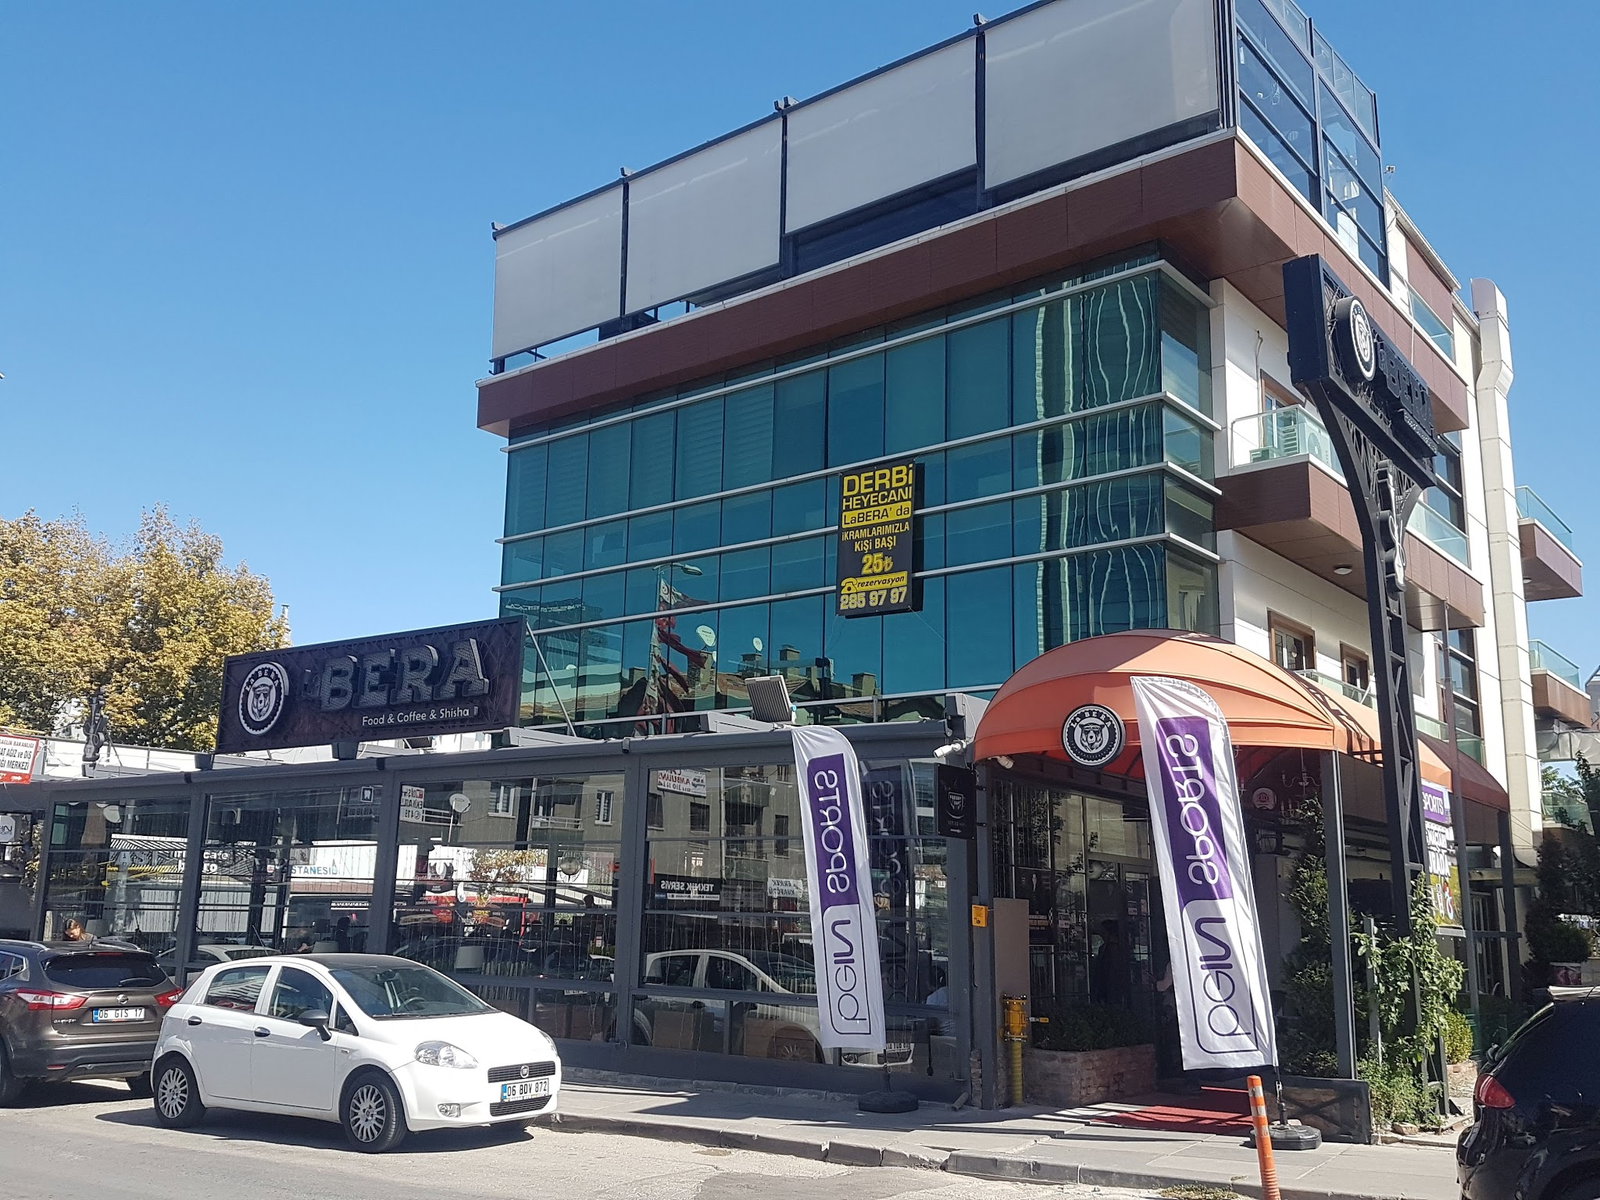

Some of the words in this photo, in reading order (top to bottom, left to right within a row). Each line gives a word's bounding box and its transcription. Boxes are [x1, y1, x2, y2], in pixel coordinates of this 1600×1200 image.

[842, 486, 912, 510] HEYECANI
[874, 536, 896, 550] BAŞI
[857, 575, 905, 588] rezervasyon
[869, 589, 887, 607] 97
[890, 586, 908, 604] 97
[321, 637, 489, 711] BERA
[362, 715, 385, 726] Food
[387, 713, 395, 724] &
[397, 711, 427, 722] Coffee
[429, 709, 437, 720] &
[440, 707, 469, 719] Shisha
[1084, 711, 1112, 728] BERA
[98, 1009, 109, 1019] 06
[508, 1085, 516, 1097] 06
[535, 1081, 547, 1093] 872
